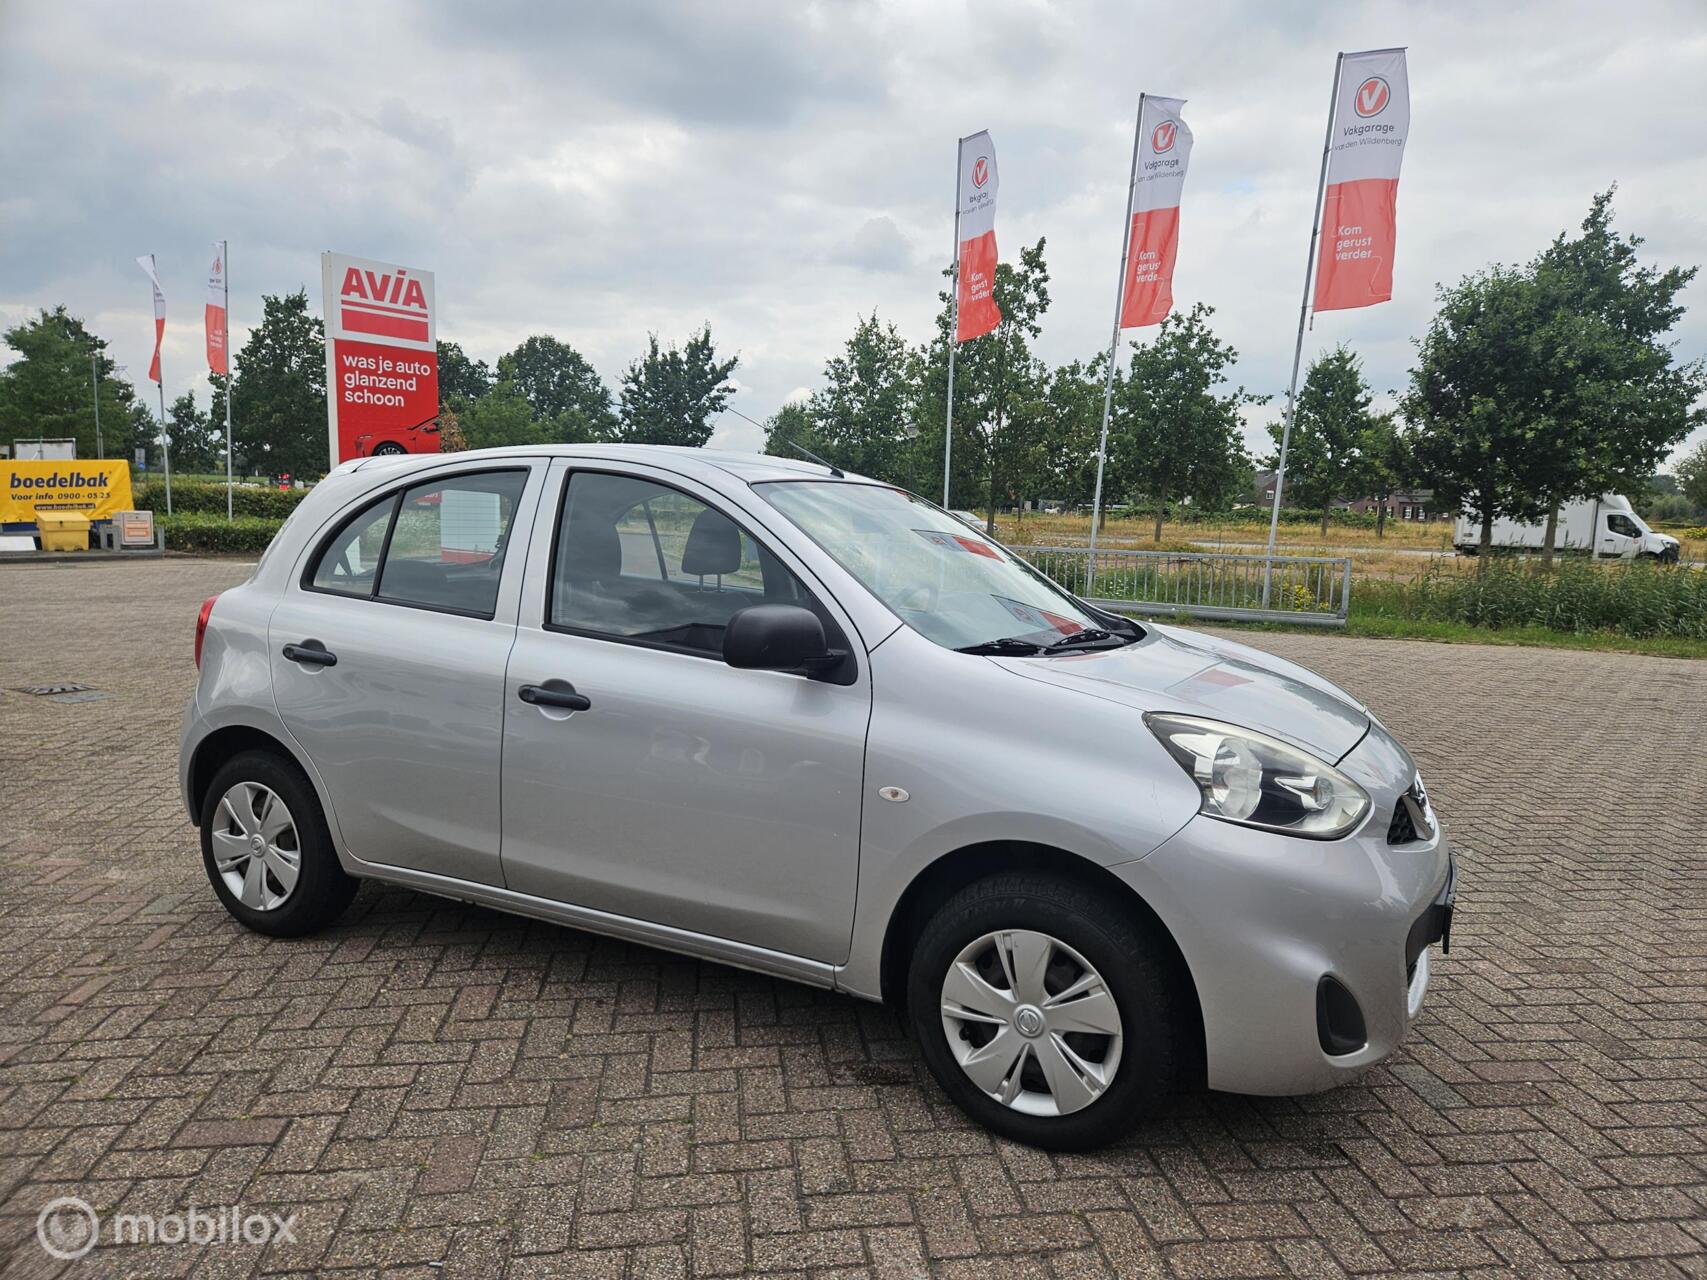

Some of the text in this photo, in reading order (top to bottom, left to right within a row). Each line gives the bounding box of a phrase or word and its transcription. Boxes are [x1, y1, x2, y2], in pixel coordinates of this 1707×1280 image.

[1343, 124, 1395, 136] Vakgarage
[1338, 225, 1362, 236] Kom
[1336, 236, 1372, 251] gerust
[1335, 249, 1372, 261] verder
[1136, 272, 1158, 283] verde
[341, 267, 428, 310] AVIA
[342, 354, 431, 376] was je auto
[344, 370, 417, 392] glanzend
[344, 389, 405, 407] schoon
[10, 472, 108, 488] boedelbak
[11, 493, 33, 501] Voor
[35, 492, 54, 500] info
[57, 492, 81, 500] 0900
